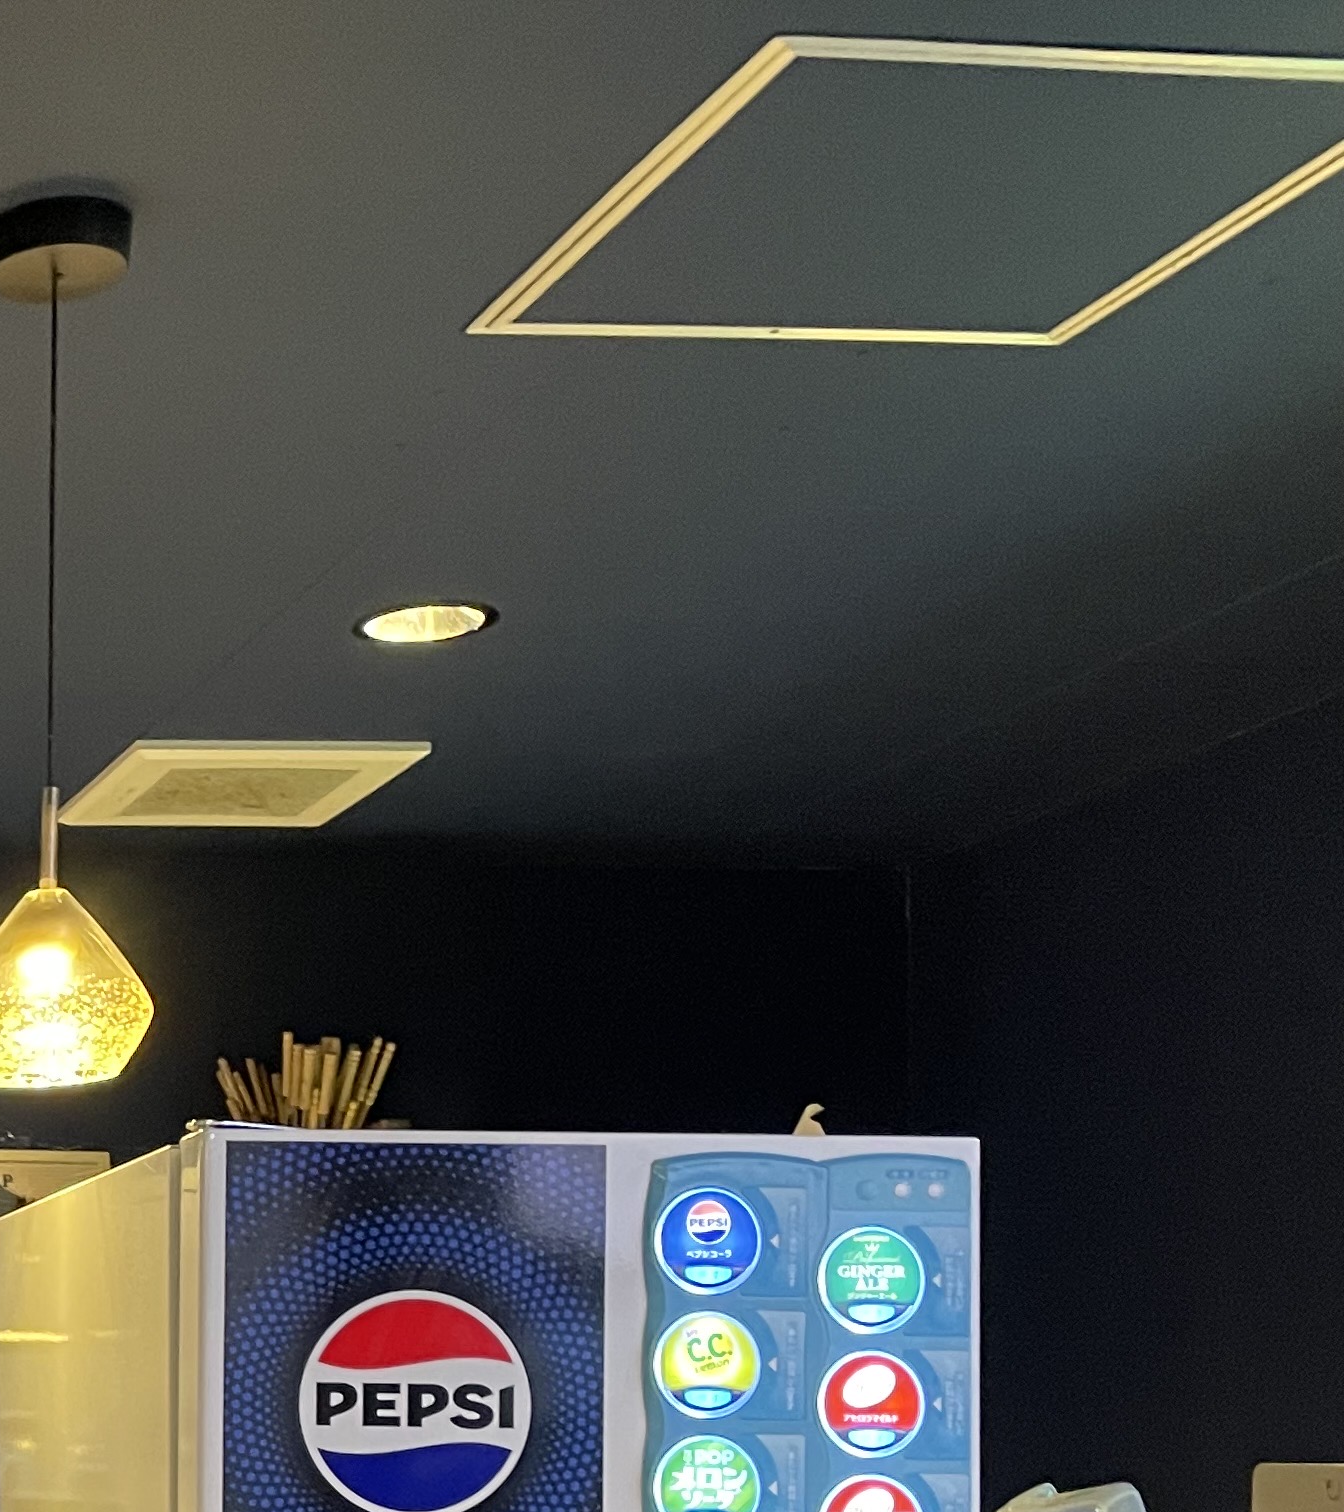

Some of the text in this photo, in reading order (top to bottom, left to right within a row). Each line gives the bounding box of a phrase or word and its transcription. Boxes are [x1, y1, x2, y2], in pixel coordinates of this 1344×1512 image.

[689, 1217, 728, 1228] PEPSI
[837, 1264, 906, 1279] GINGER
[854, 1277, 890, 1291] ALE
[316, 1381, 515, 1429] PEPSI
[695, 1448, 734, 1466] POP
[669, 1466, 747, 1491] メロン
